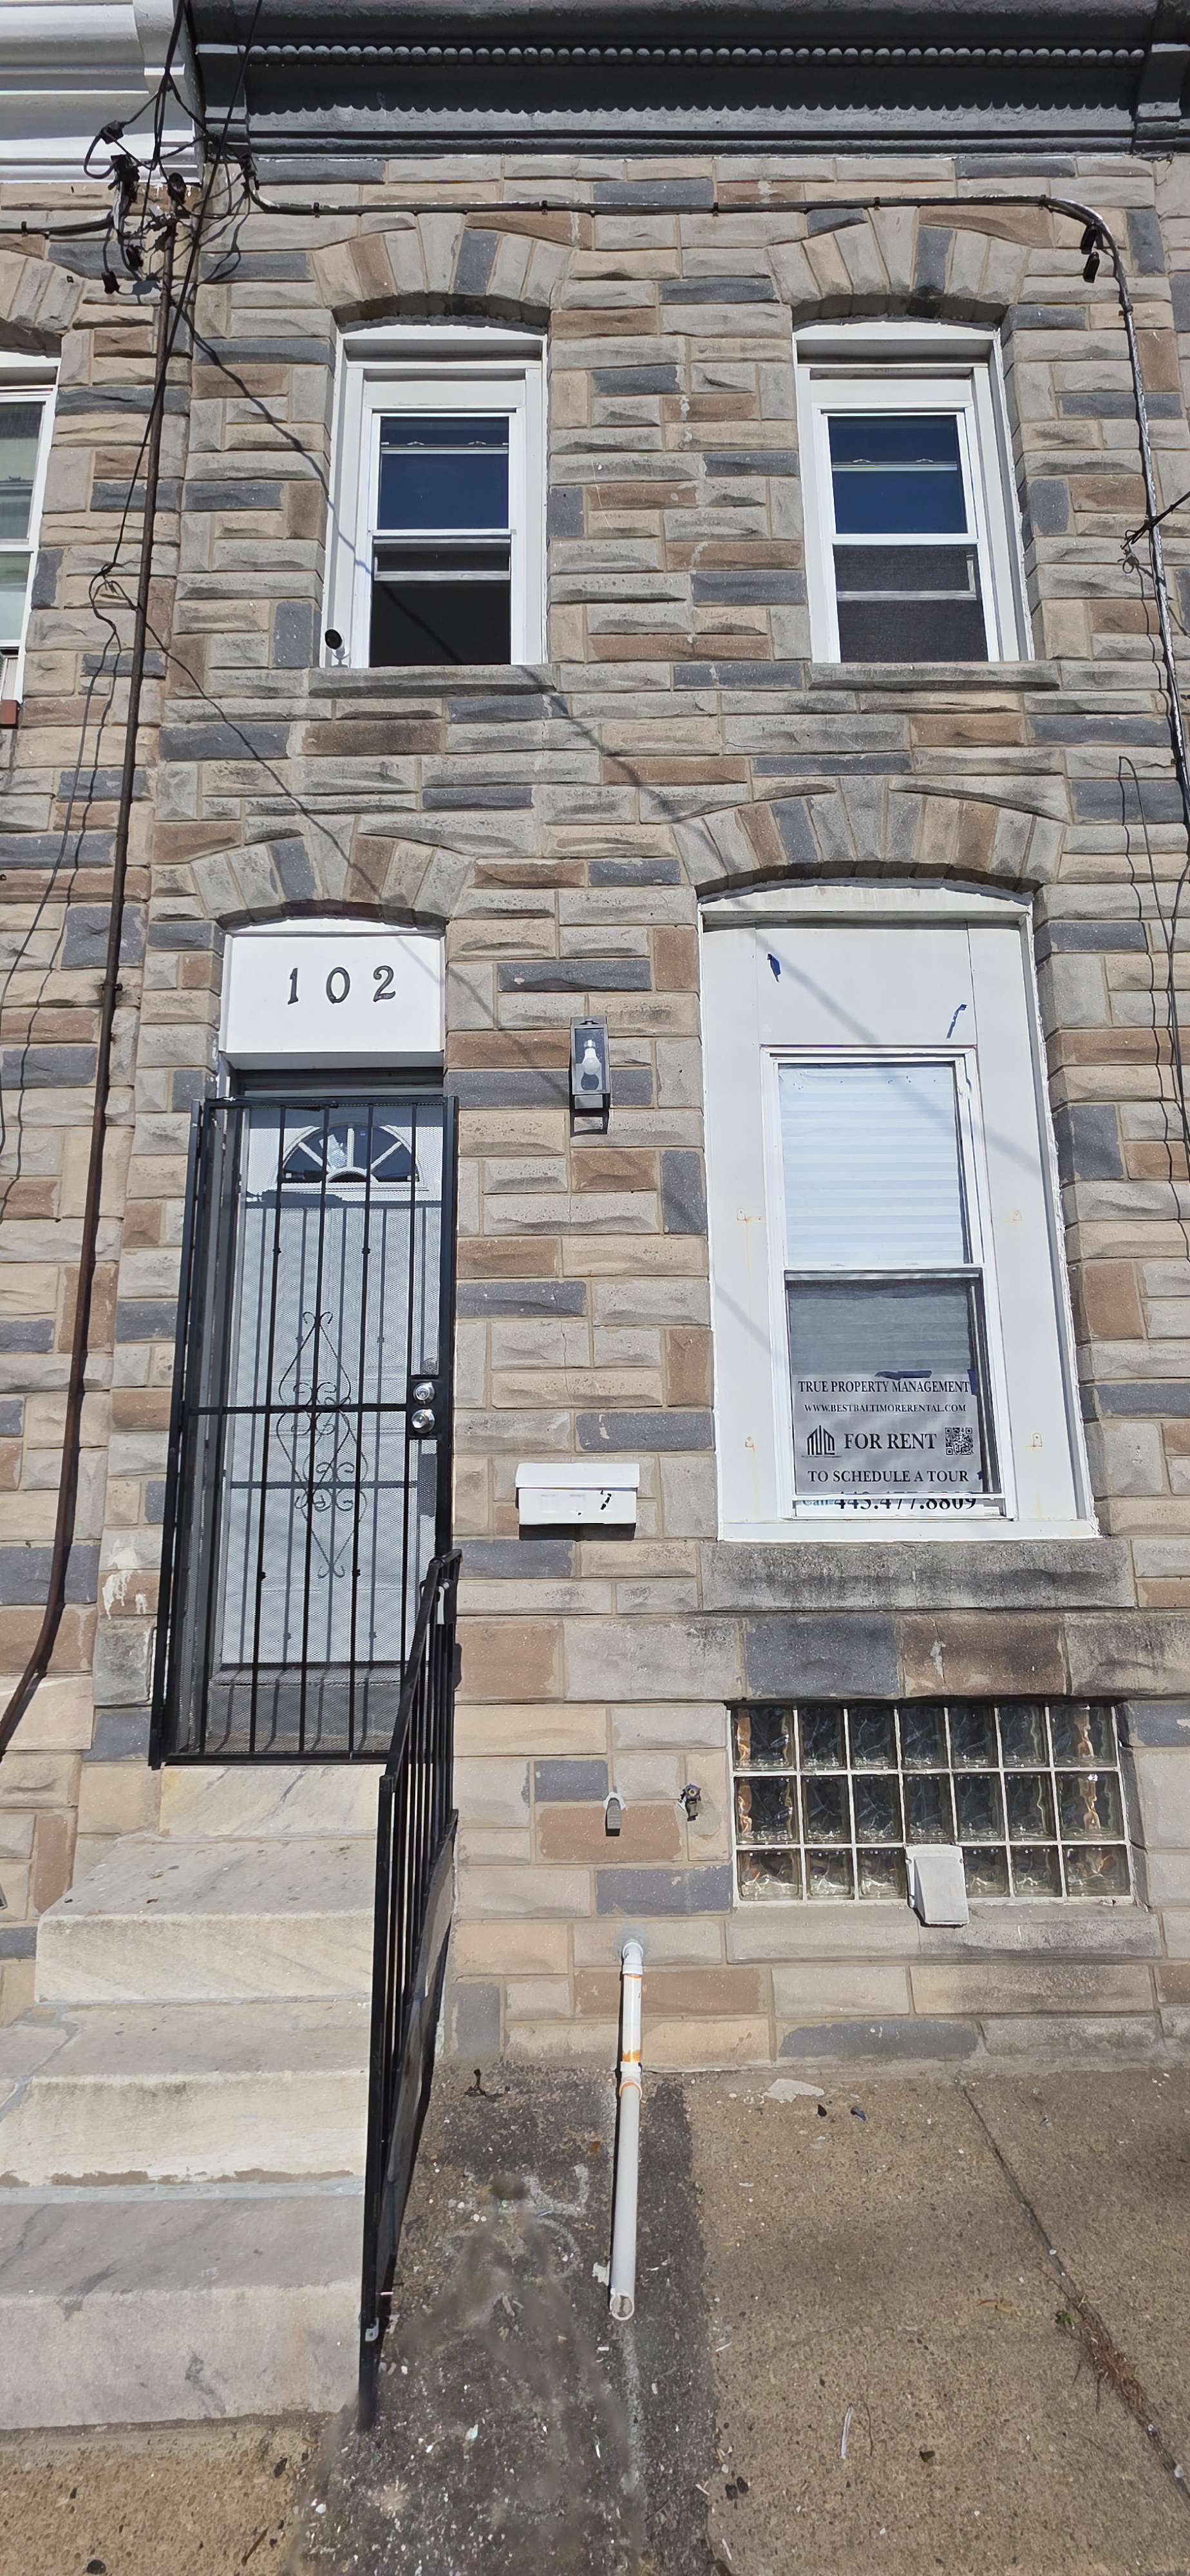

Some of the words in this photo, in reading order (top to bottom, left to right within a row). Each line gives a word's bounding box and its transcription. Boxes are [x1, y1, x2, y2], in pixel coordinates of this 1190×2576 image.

[287, 965, 396, 1005] 102
[798, 1381, 829, 1392] TRUE
[831, 1381, 889, 1392] PROPERTY
[892, 1381, 970, 1393] MANAGEMENT
[804, 1404, 966, 1412] WWW.BESTBALTIMORERENTAL.COM
[844, 1434, 883, 1449] FOR
[887, 1434, 937, 1449] RENT
[808, 1471, 828, 1482] TO
[833, 1471, 911, 1482] SCHEDULE
[914, 1471, 924, 1482] A
[927, 1471, 969, 1482] TOUR
